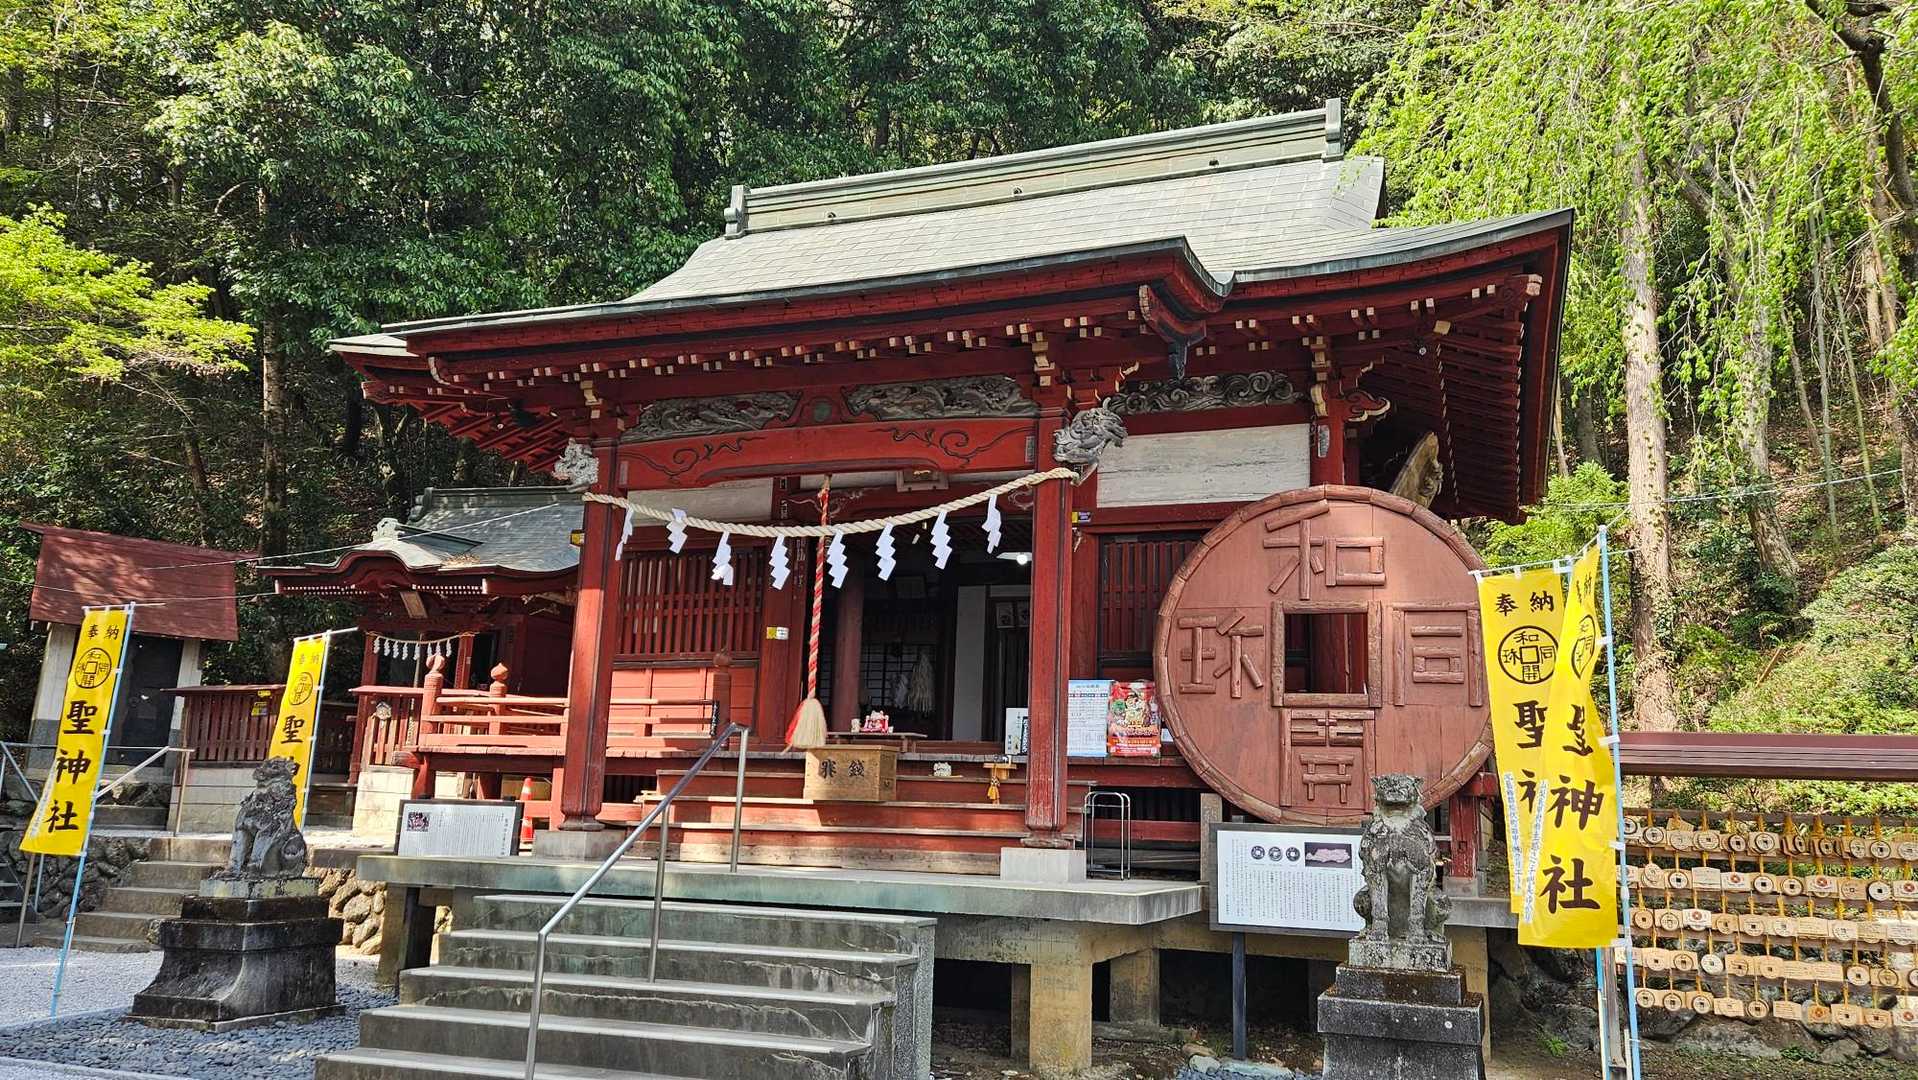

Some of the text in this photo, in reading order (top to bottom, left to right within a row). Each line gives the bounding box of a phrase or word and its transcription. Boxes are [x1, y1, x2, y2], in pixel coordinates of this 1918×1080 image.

[1263, 498, 1387, 600] 和
[87, 624, 120, 640] 奉納
[1389, 600, 1483, 707] 同
[1495, 591, 1555, 617] 奉納
[43, 699, 98, 833] 聖神社
[1279, 708, 1376, 813] 開
